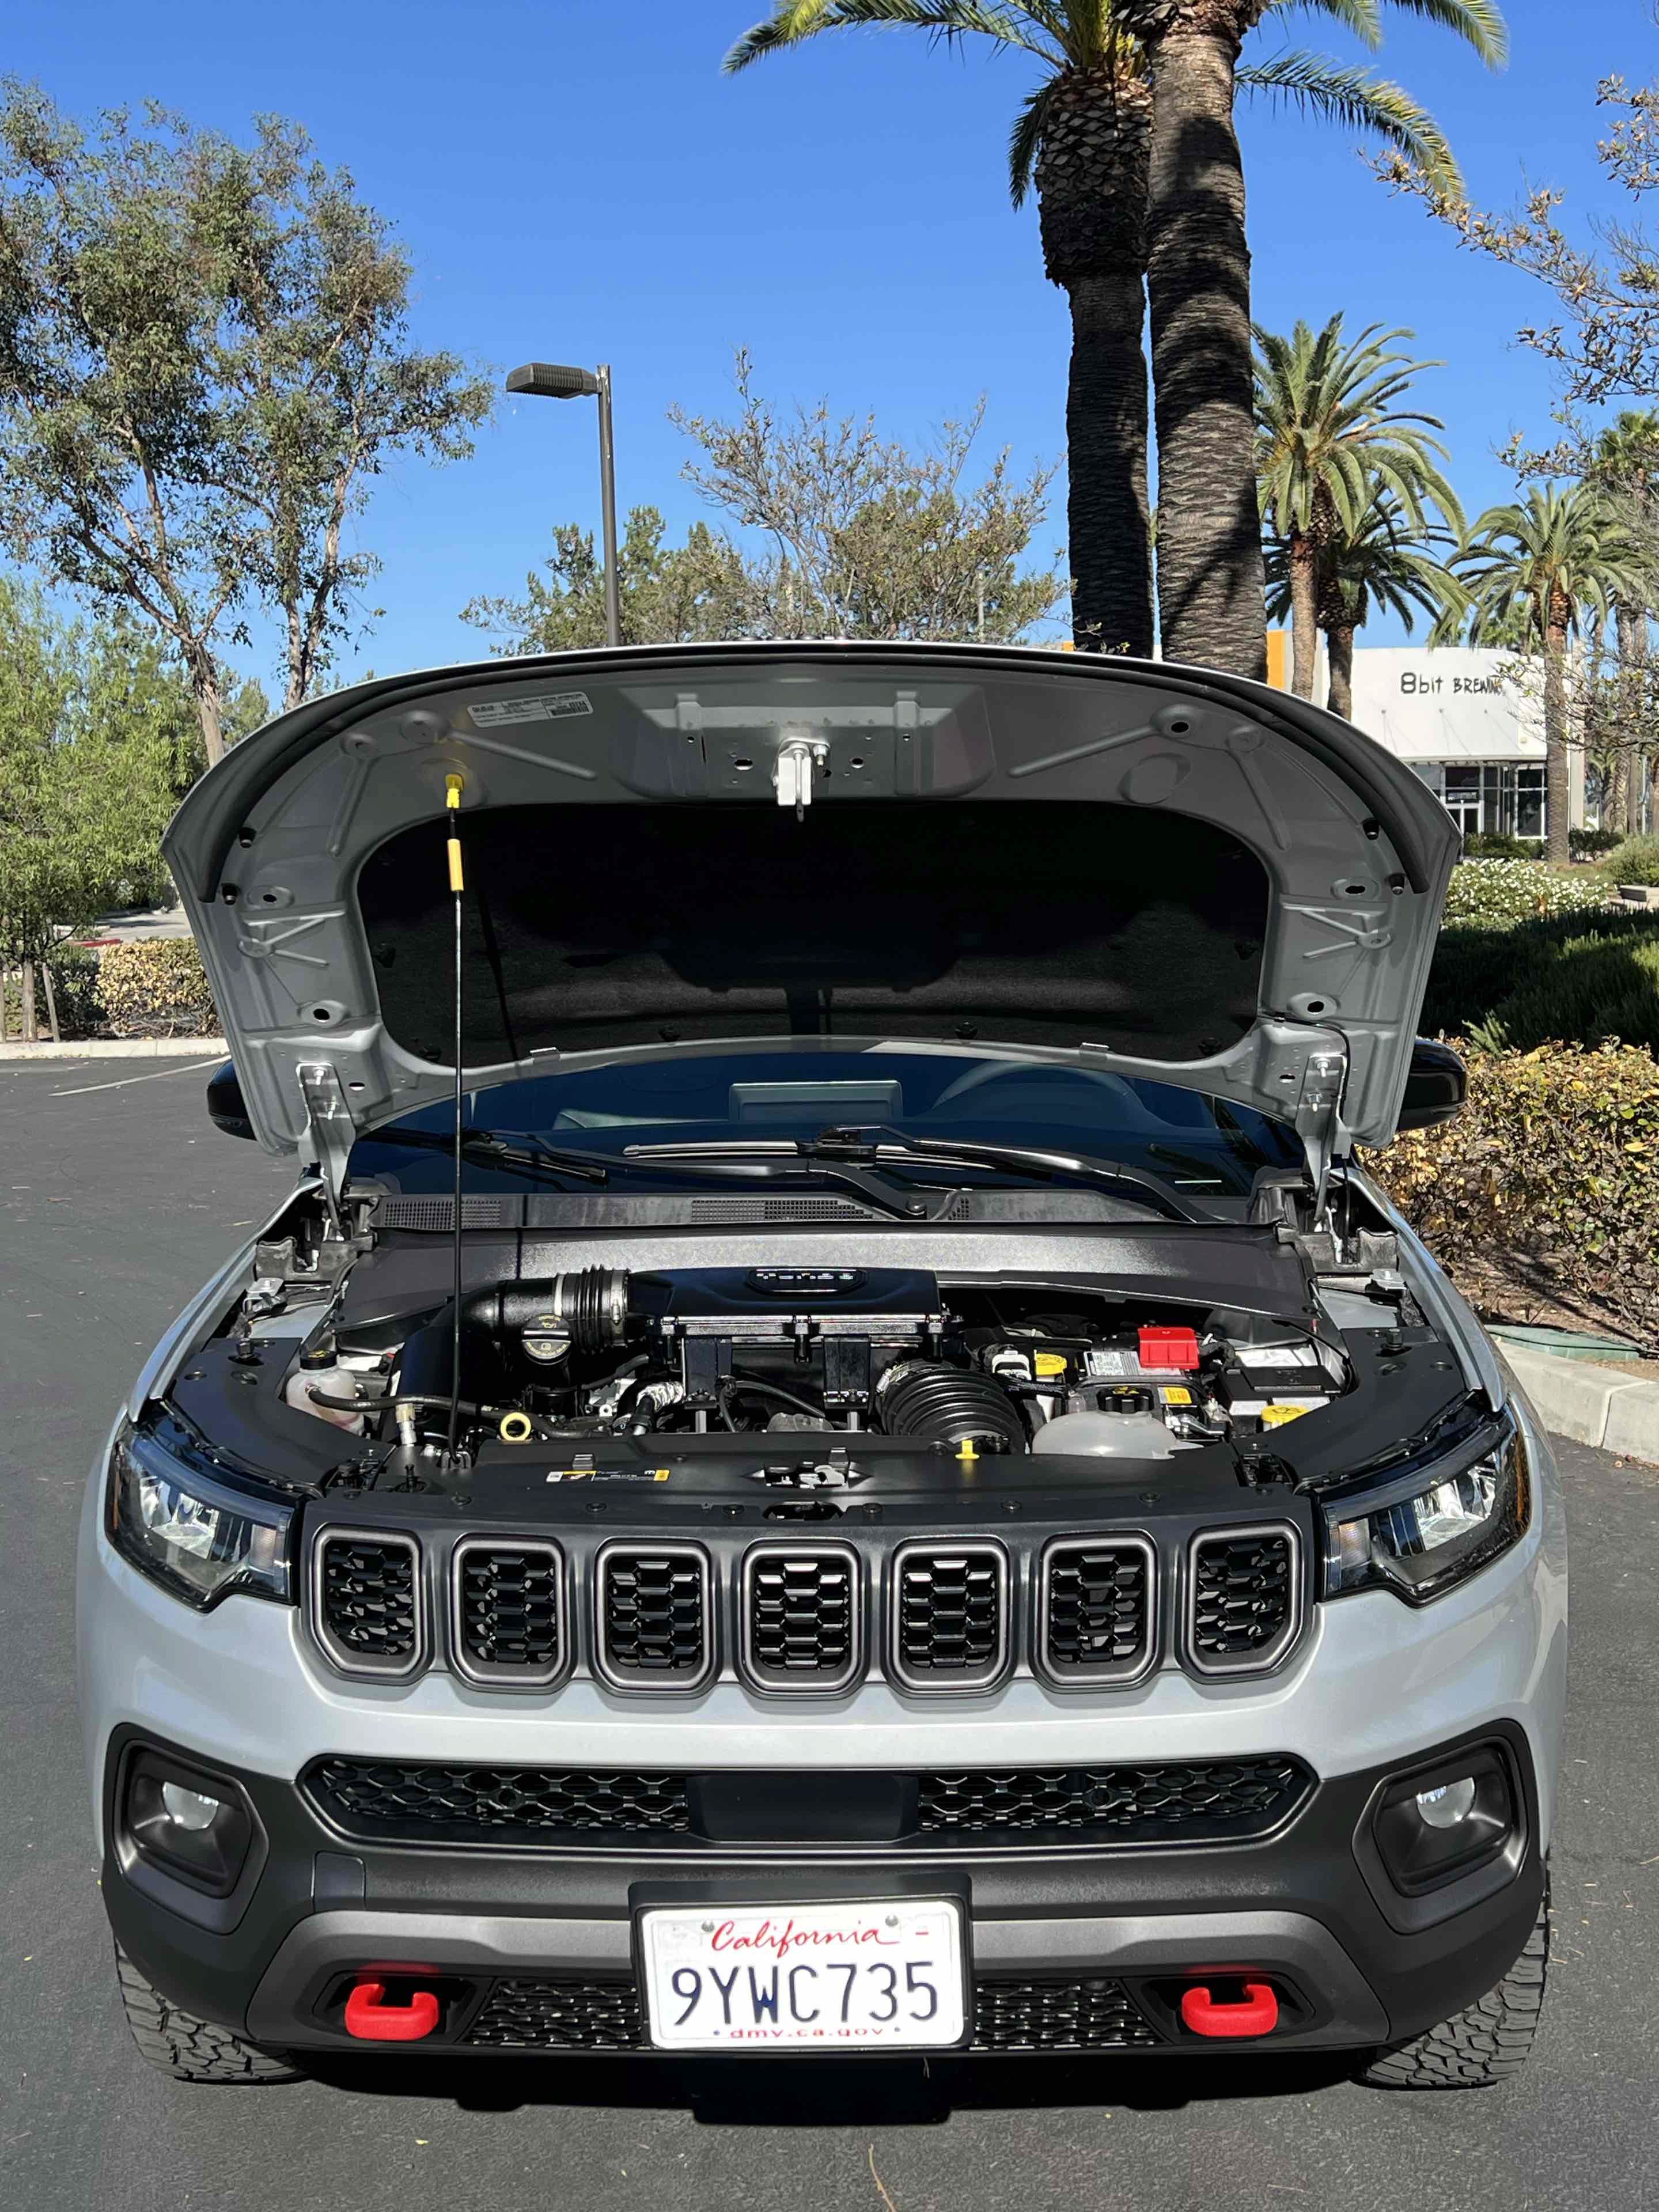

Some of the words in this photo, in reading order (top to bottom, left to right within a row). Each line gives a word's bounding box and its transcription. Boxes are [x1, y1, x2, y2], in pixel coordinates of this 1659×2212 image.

[711, 1919, 900, 1959] California
[672, 1961, 938, 2025] 9YWC735
[730, 2027, 884, 2039] dmv.ca.gov
